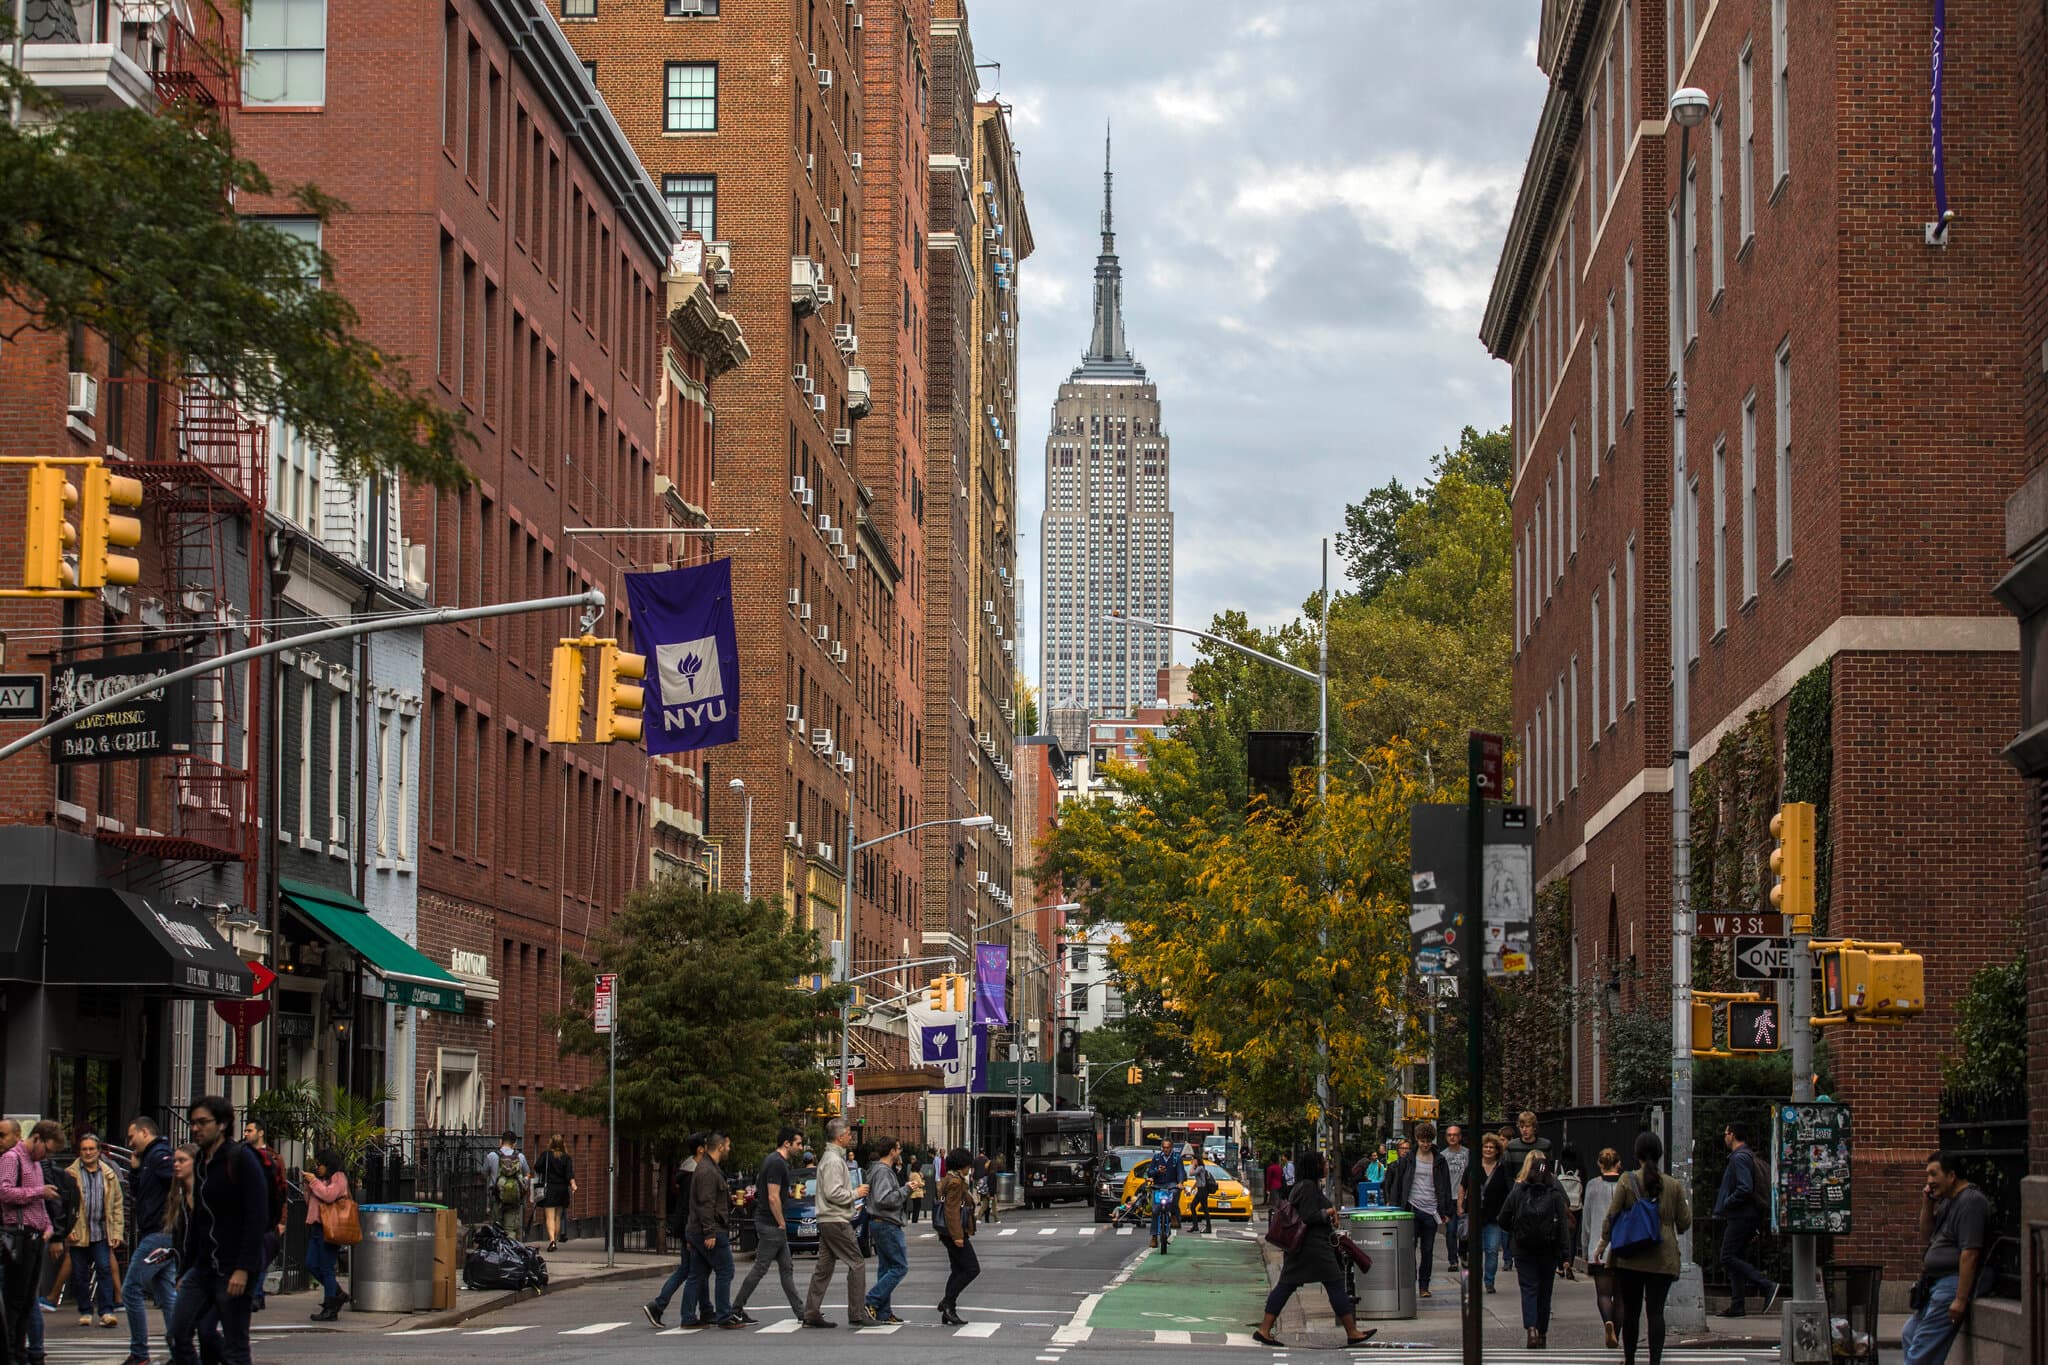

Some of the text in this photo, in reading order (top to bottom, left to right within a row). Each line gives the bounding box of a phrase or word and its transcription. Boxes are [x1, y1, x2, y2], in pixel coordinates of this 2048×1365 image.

[105, 710, 146, 727] MUSIC
[663, 699, 727, 732] NYU
[64, 730, 161, 756] BAR & GRILL
[1713, 917, 1764, 934] W 3 St
[1749, 950, 1790, 966] ONE
